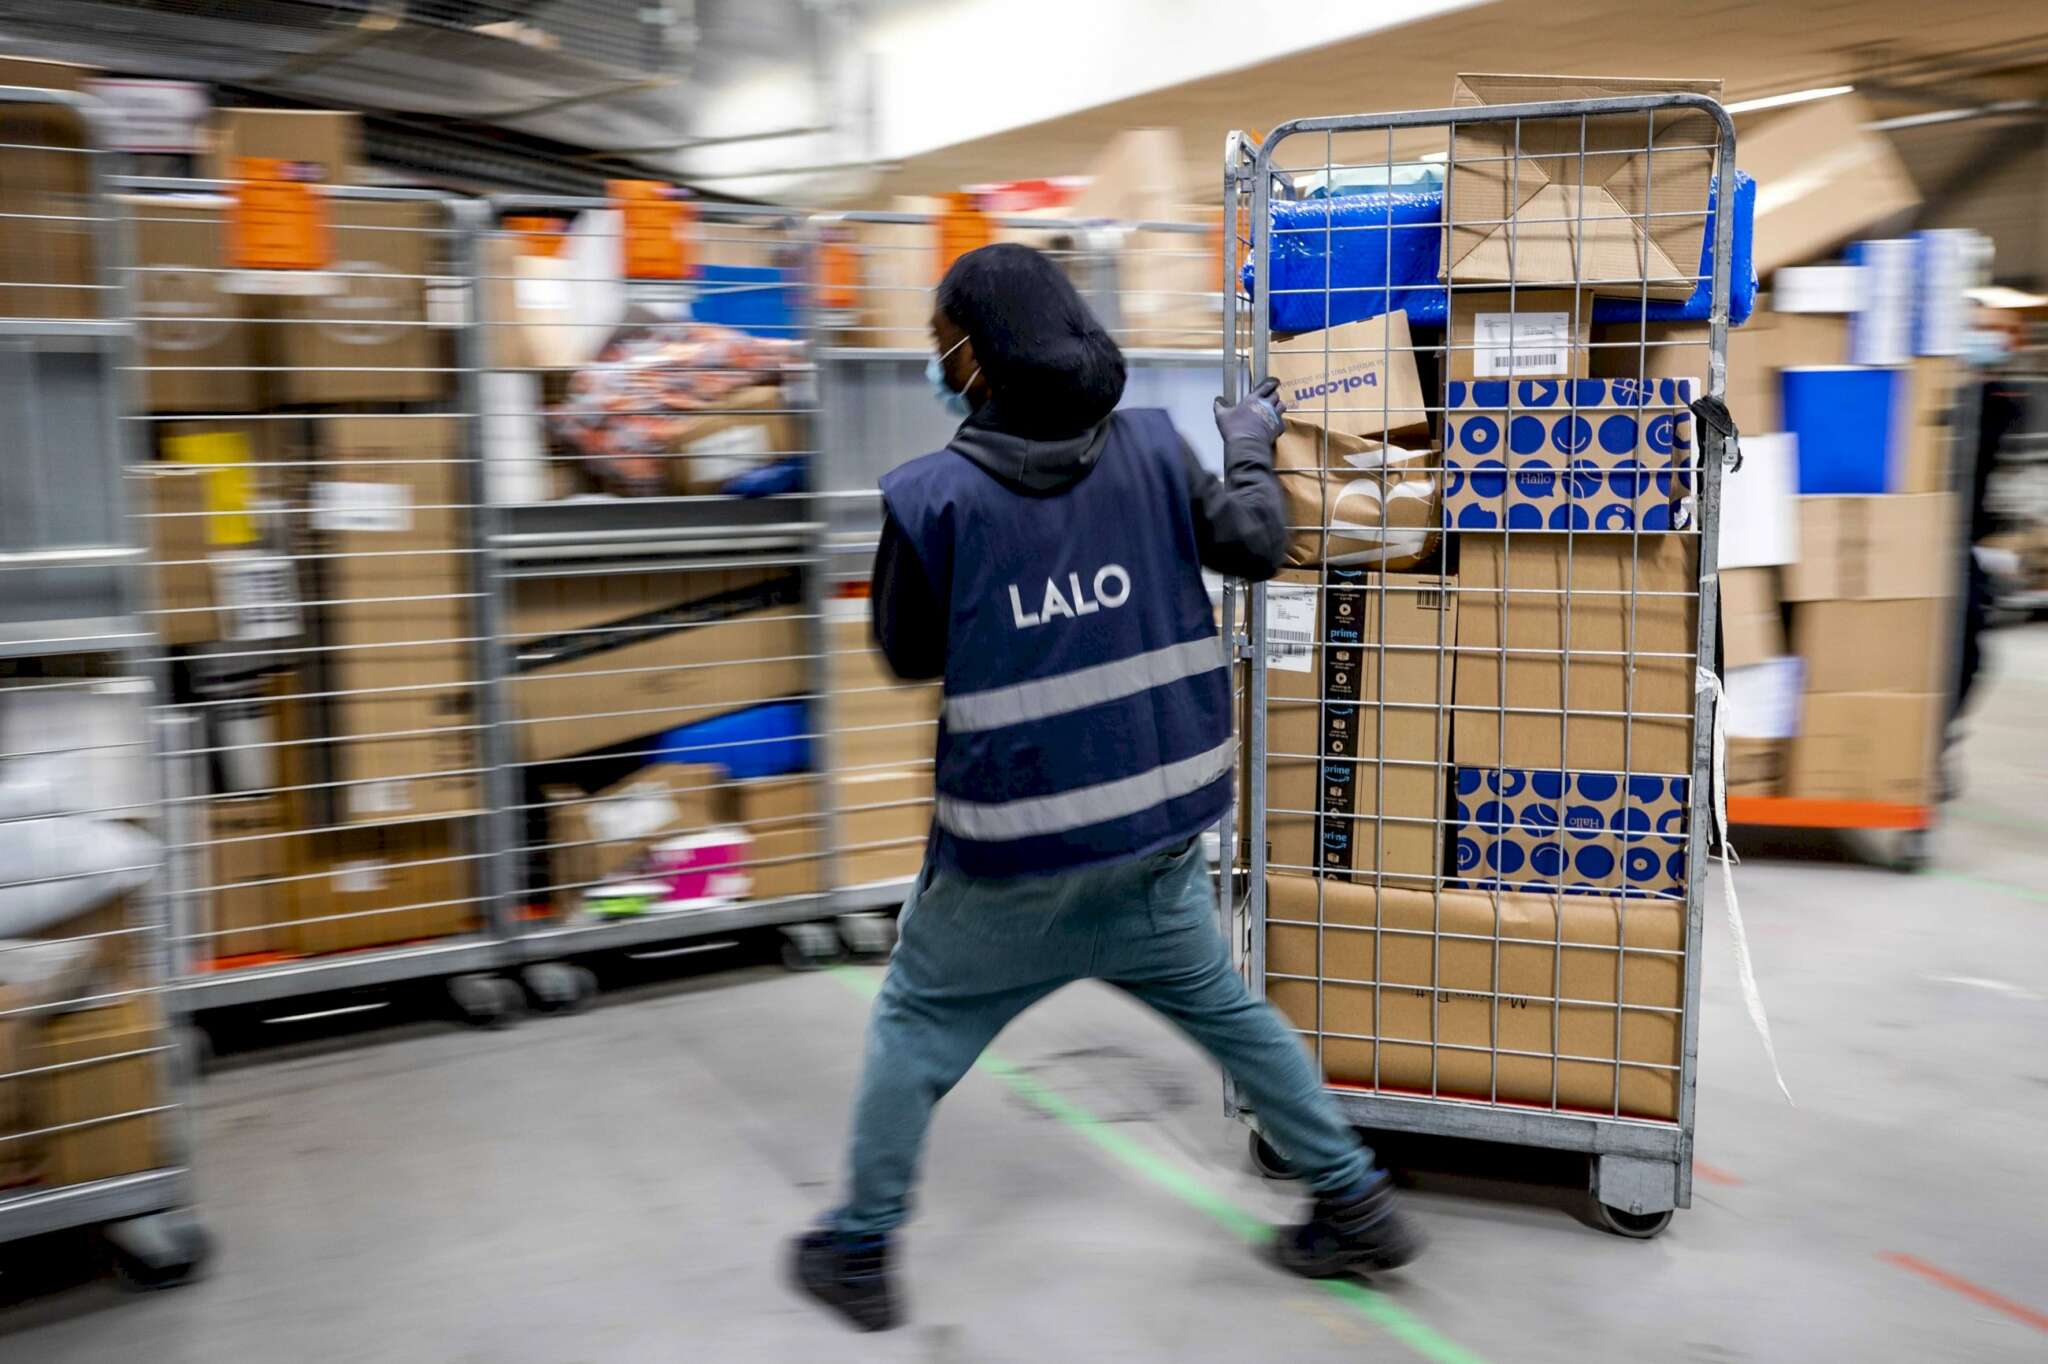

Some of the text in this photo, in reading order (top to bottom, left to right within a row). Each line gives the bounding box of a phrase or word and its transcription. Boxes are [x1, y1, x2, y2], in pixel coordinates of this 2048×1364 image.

[1294, 371, 1378, 401] bol.com
[1520, 472, 1552, 485] Hallo
[1007, 563, 1132, 630] LALO
[1330, 627, 1359, 640] prime
[1568, 817, 1600, 829] Hallo
